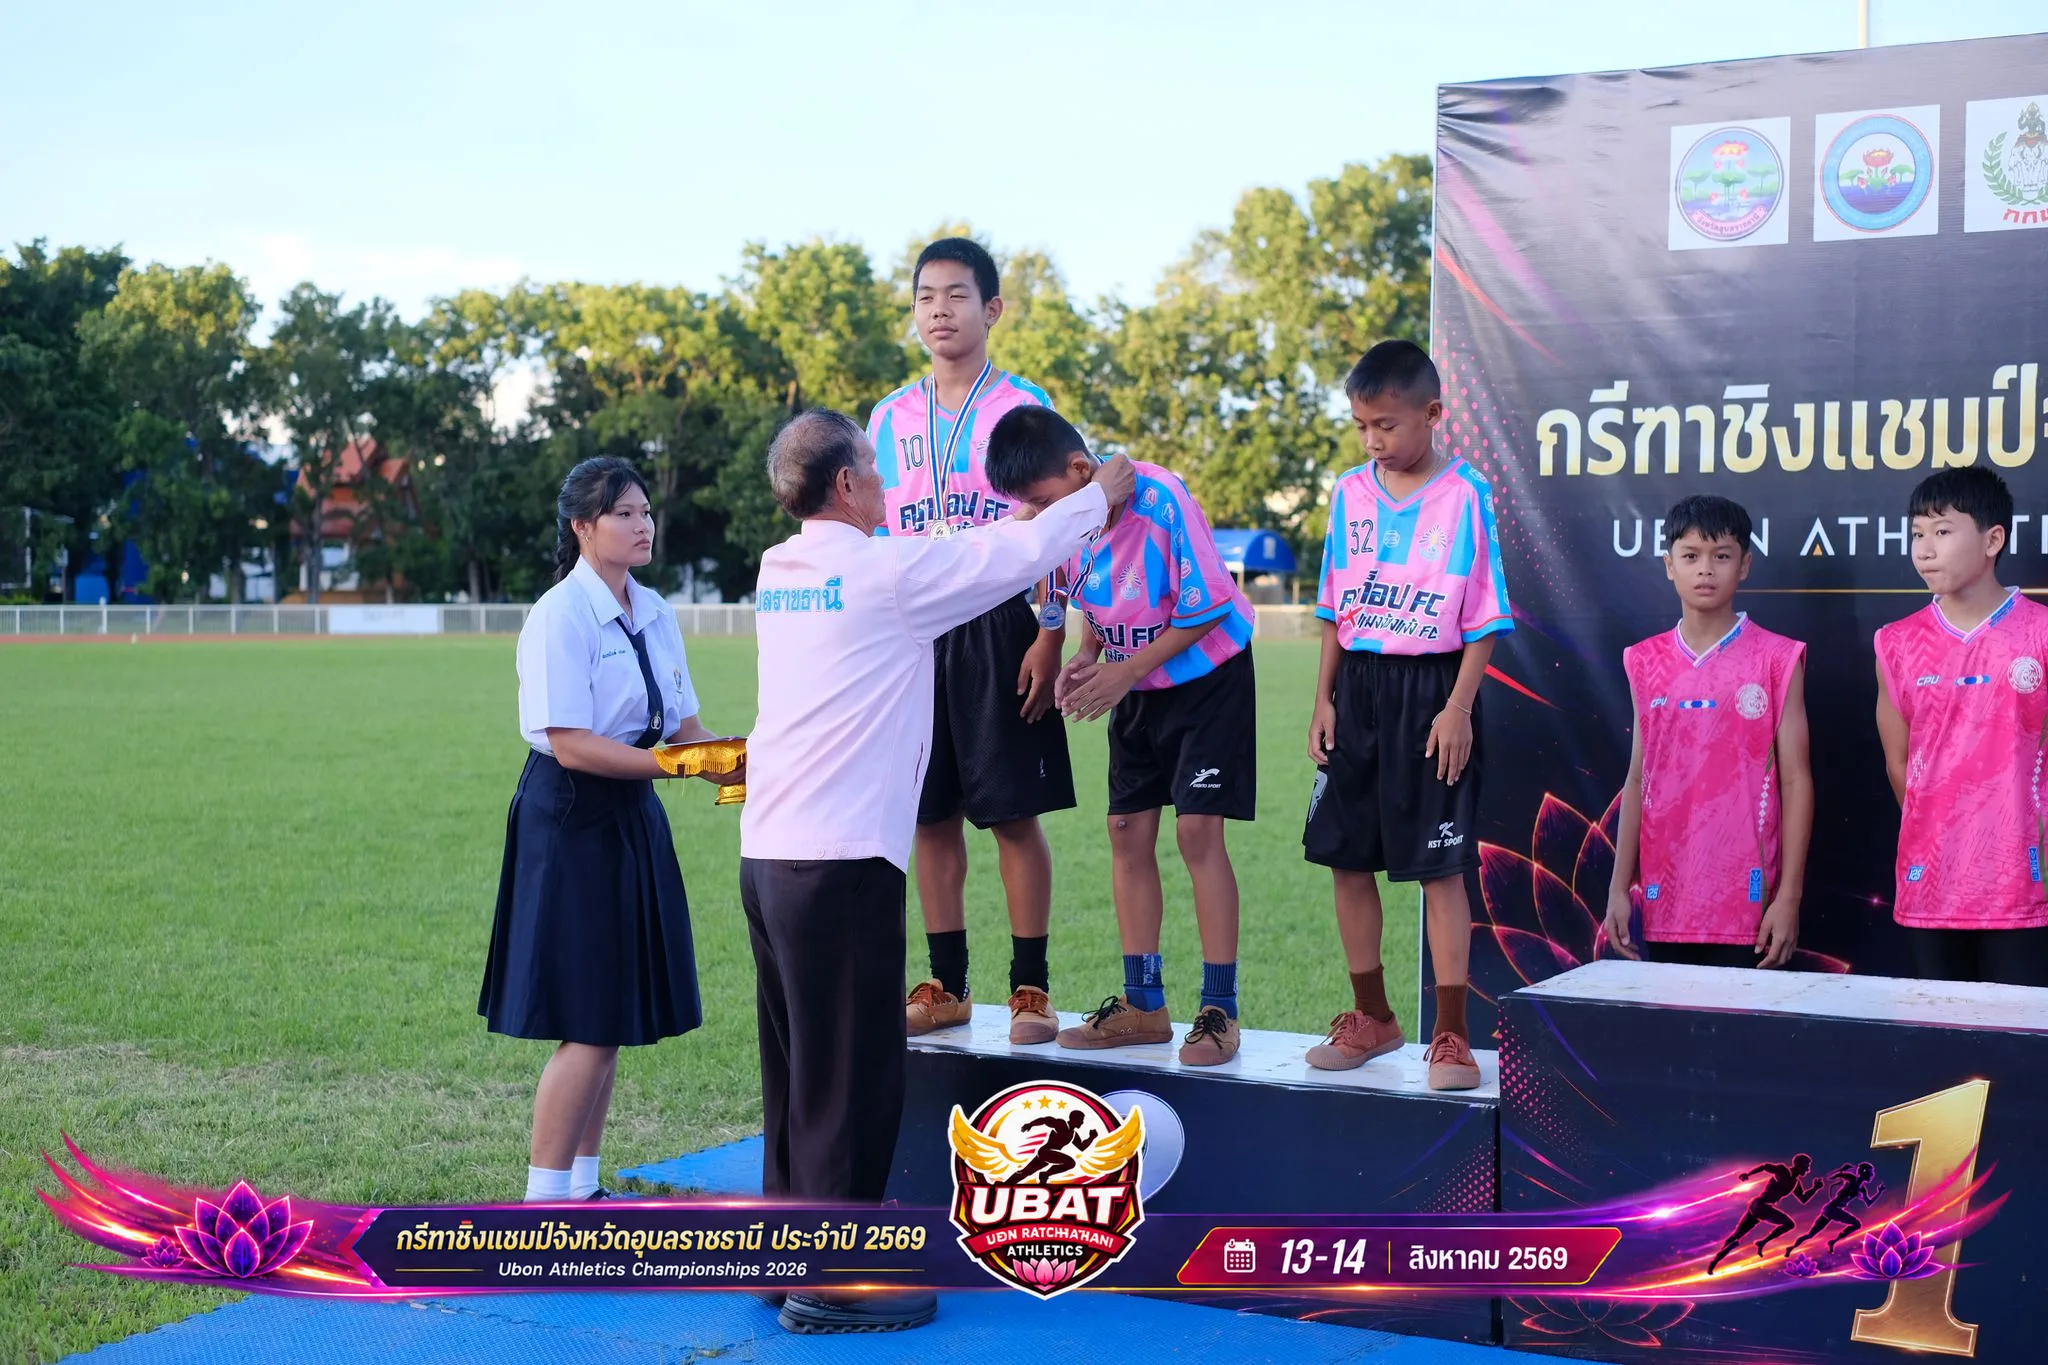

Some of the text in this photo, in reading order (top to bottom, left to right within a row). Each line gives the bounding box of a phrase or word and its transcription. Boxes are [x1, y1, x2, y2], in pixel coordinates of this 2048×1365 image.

[1536, 363, 2048, 477] กรีฑาชิงแชมป์
[900, 434, 924, 471] 10
[1349, 519, 1374, 555] 32
[1408, 590, 1446, 617] FC
[1418, 625, 1439, 640] FC
[1443, 834, 1464, 848] SPORT
[1850, 1080, 1991, 1358] 1
